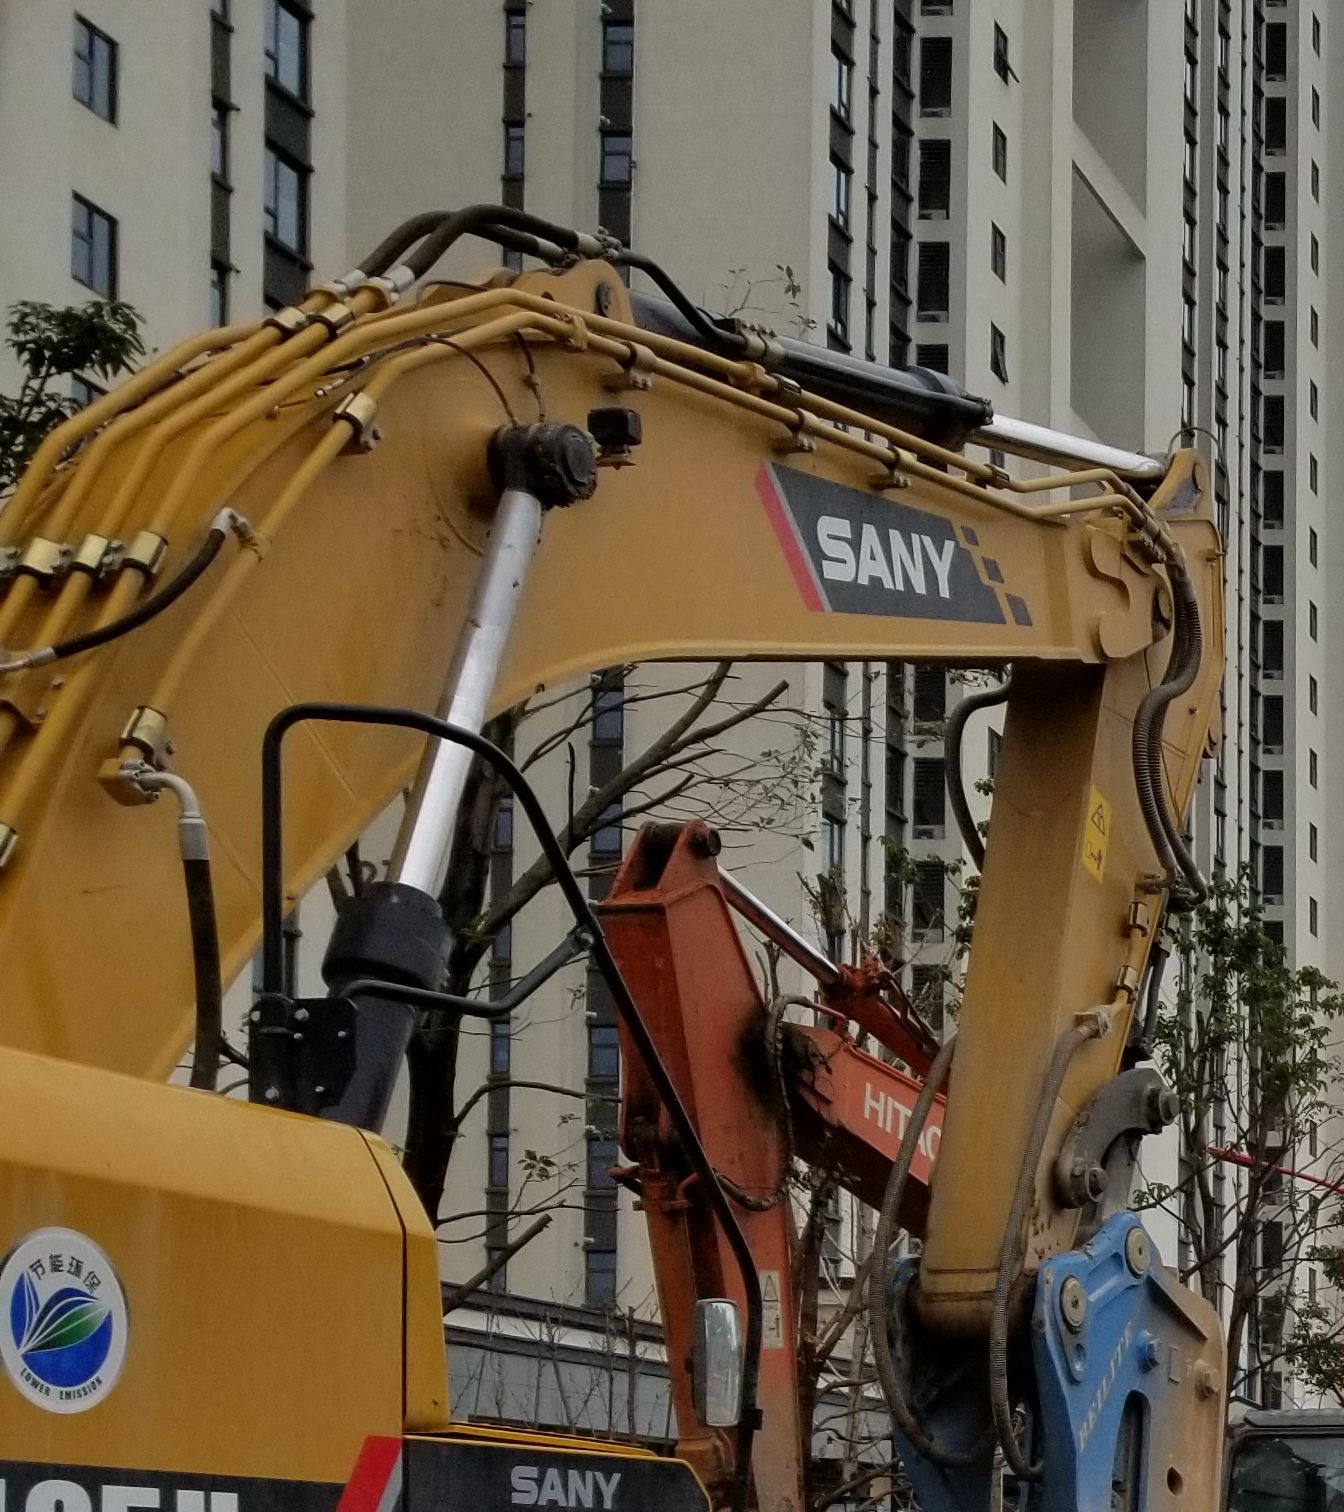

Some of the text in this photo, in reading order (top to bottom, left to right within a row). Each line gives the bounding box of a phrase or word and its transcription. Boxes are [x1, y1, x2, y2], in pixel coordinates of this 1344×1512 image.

[816, 515, 955, 599] SANY
[28, 1254, 102, 1294] 节能环保
[20, 1367, 104, 1401] LOWER EMISSION
[511, 1465, 622, 1510] SANY
